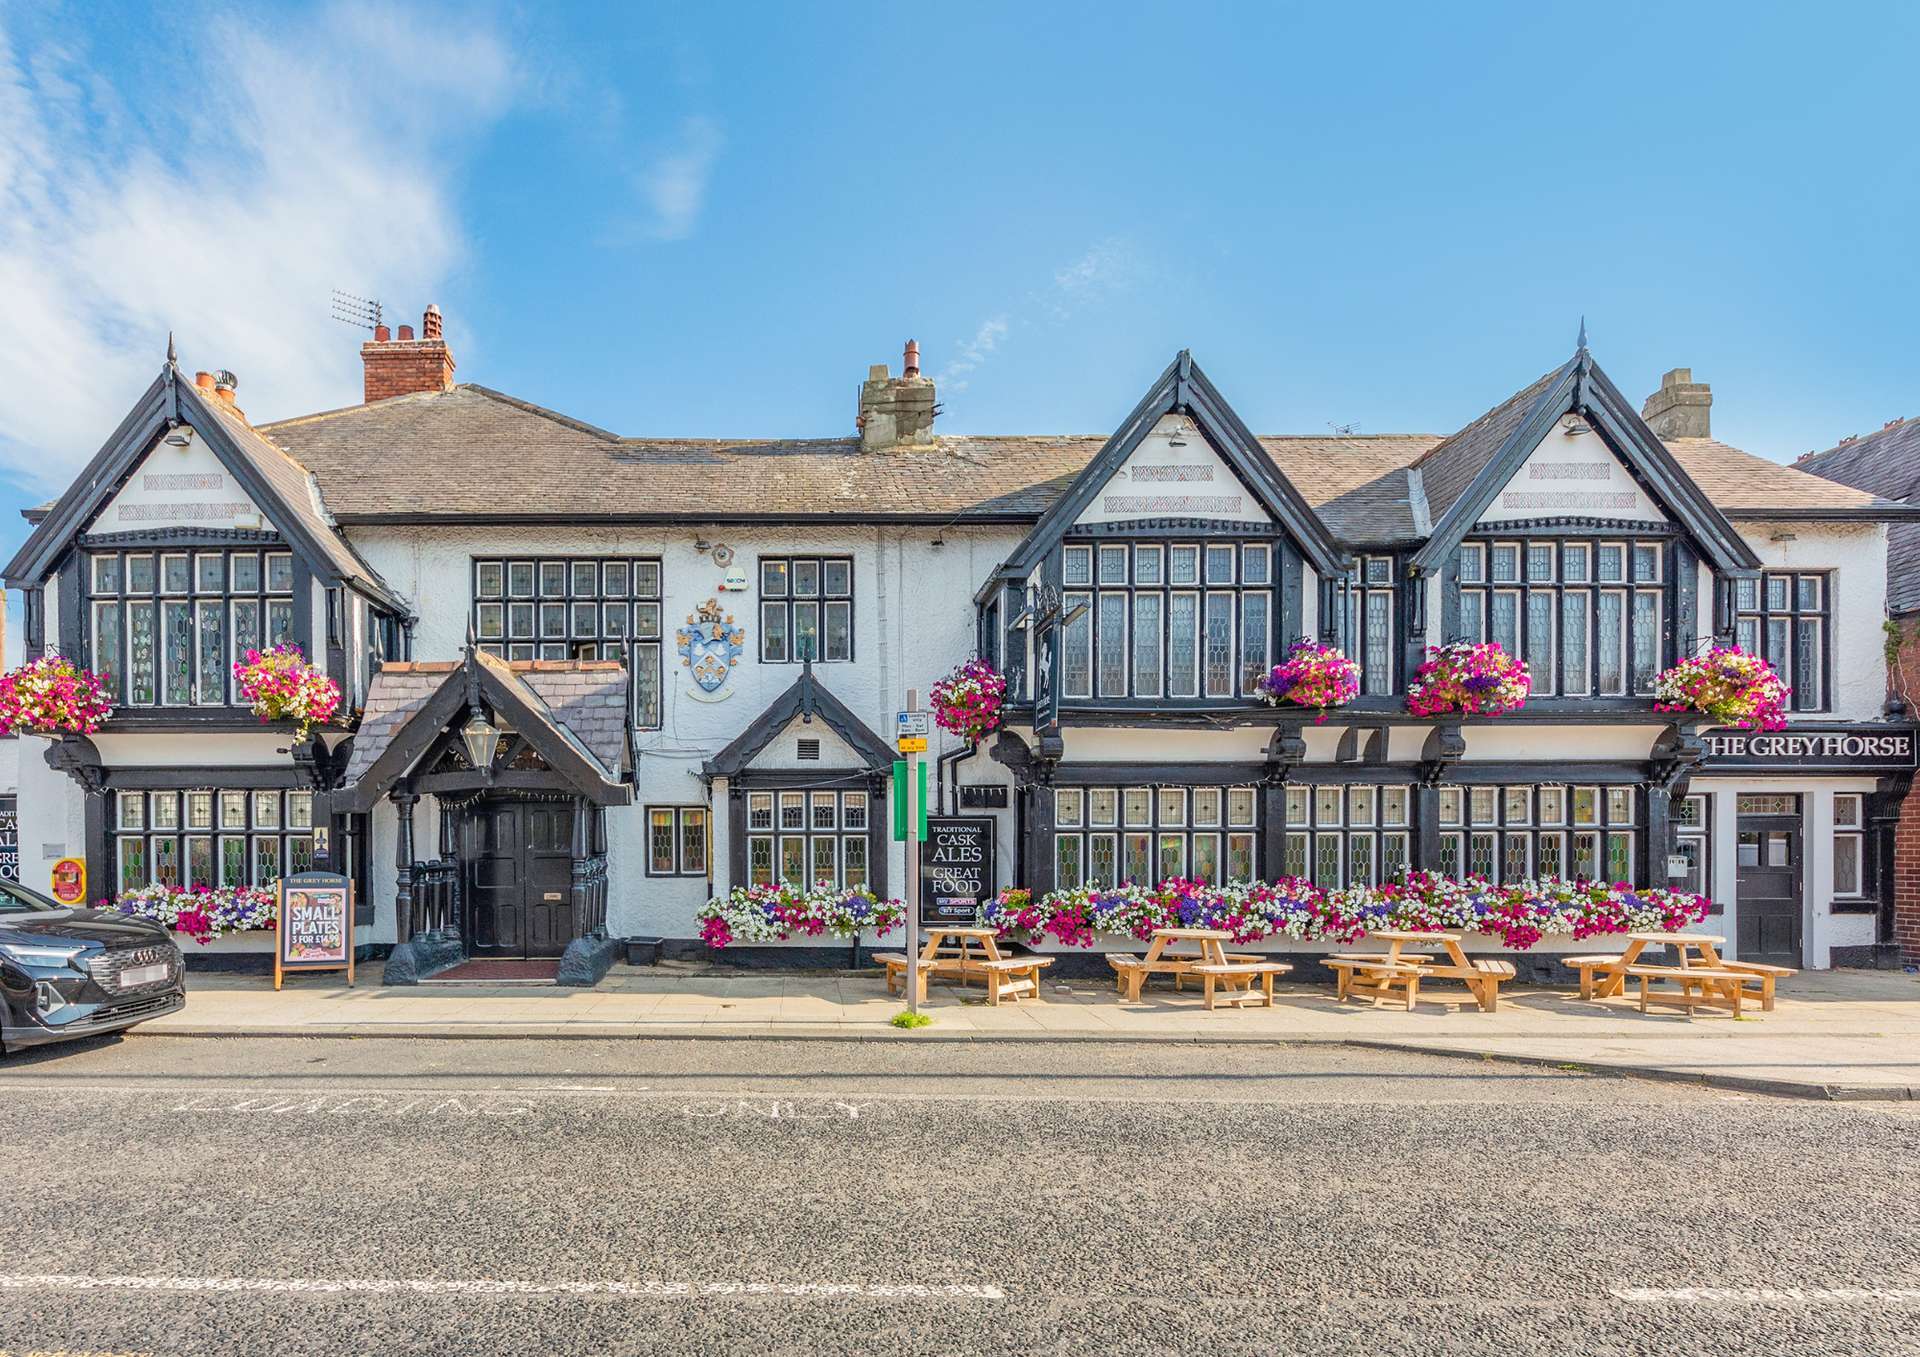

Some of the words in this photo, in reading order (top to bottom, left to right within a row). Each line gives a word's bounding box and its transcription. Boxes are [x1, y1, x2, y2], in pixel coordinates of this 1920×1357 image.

[1749, 736, 1818, 756] GREY
[1822, 736, 1910, 756] HORSE
[937, 834, 977, 846] CASK
[931, 847, 983, 863] ALES
[932, 867, 982, 879] GREAT
[932, 880, 982, 893] FOOD
[292, 906, 339, 921] SMALL
[292, 921, 339, 935] PLATES
[291, 935, 297, 944] 3
[299, 935, 314, 944] FOR
